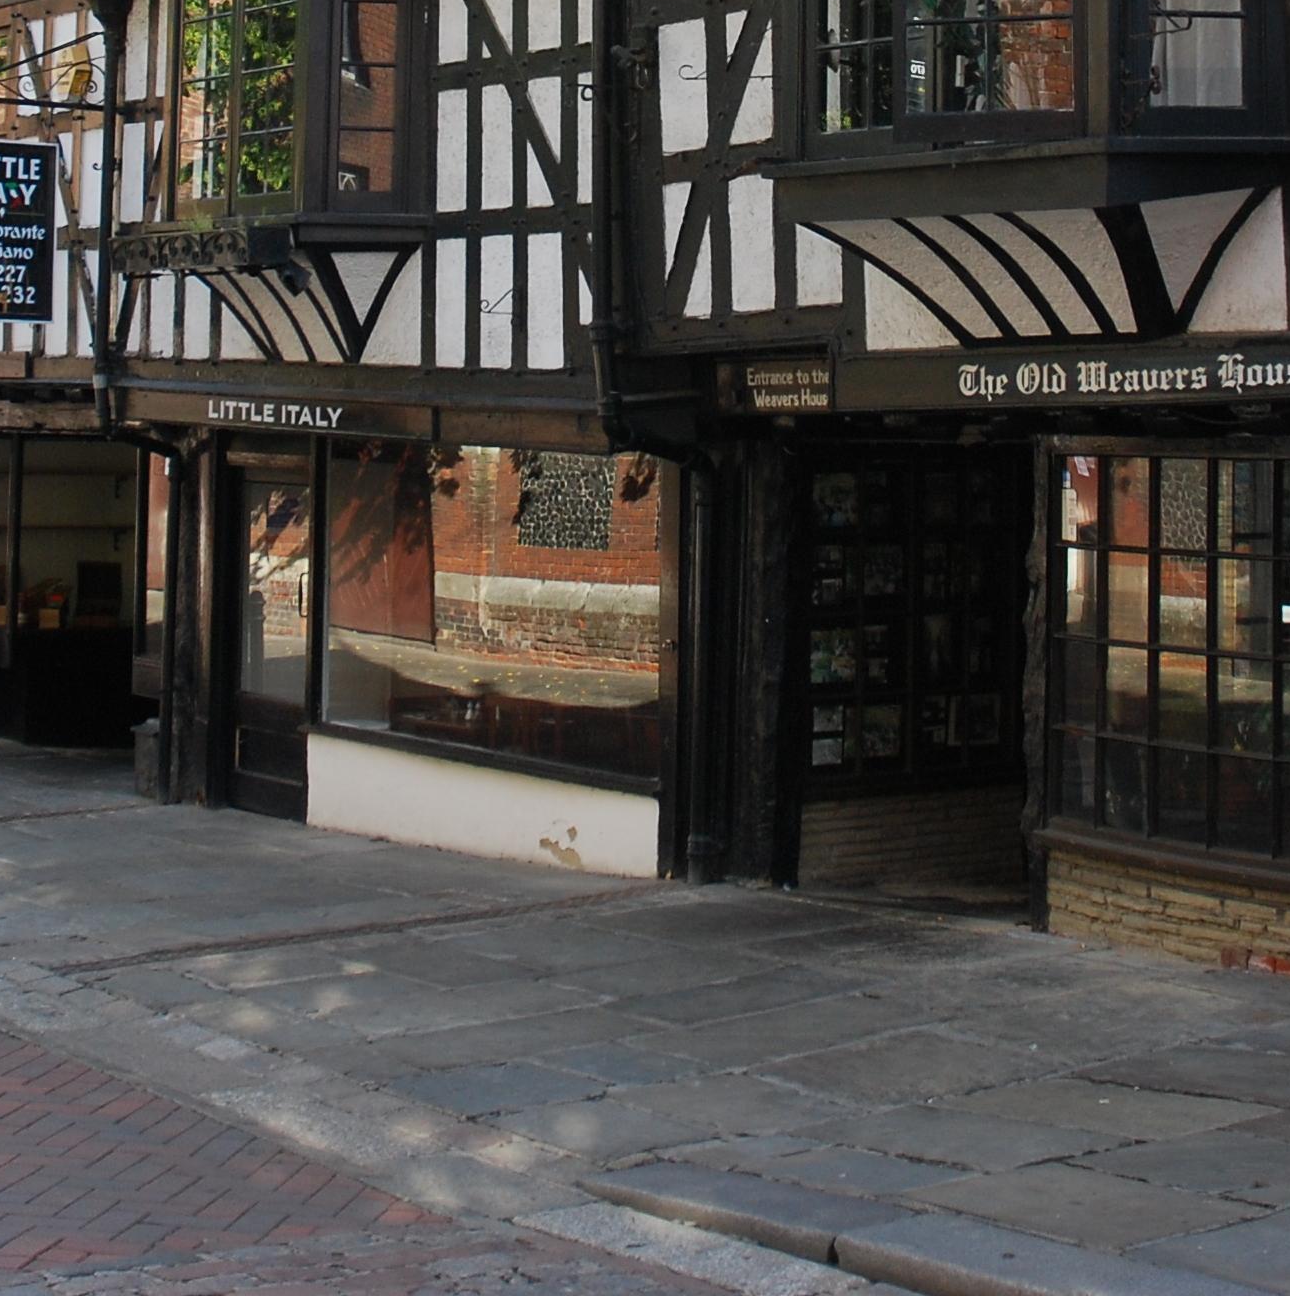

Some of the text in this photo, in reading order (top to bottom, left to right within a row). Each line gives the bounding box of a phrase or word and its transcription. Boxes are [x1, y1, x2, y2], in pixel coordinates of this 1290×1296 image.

[747, 368, 829, 386] Entrance to the
[958, 364, 1009, 402] The
[1015, 362, 1067, 395] Old
[1077, 360, 1208, 393] Weavers
[753, 388, 829, 407] Weavers Hous
[208, 400, 343, 428] LITTLE ITALY
